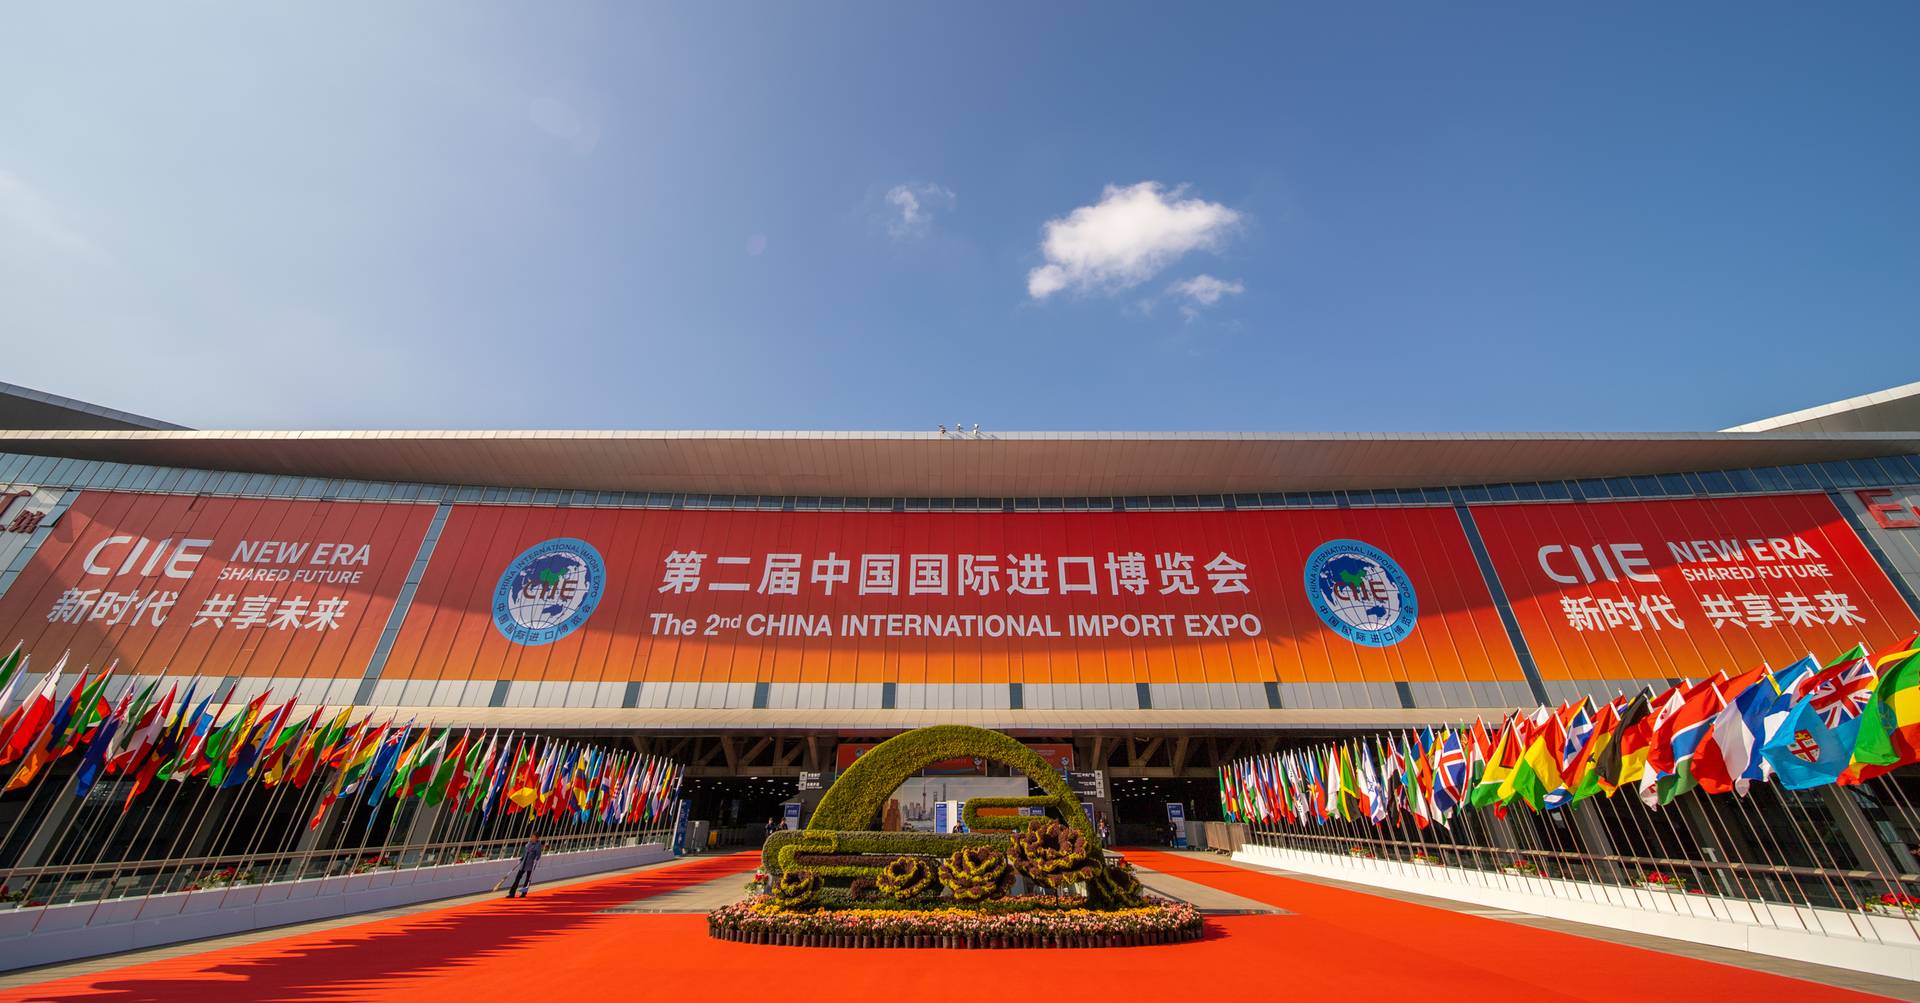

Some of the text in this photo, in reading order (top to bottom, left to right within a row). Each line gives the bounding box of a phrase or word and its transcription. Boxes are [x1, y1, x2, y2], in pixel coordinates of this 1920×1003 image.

[82, 535, 215, 580] CIIE
[230, 540, 371, 566] NEW ERA
[1537, 543, 1660, 584] CIIE
[1667, 536, 1821, 563] NEW ERA
[217, 567, 364, 584] SHARED FUTURE
[499, 543, 601, 598] CHINA INTERNATIONAL IMPORT EXPO
[657, 551, 1250, 596] 第二届中国国际进口博览会
[1309, 544, 1411, 599] CHINA INTERNATIONAL IMPORT EXPO
[1682, 563, 1833, 582] SHARED FUTURE
[47, 588, 350, 632] 新时代 共享未来
[649, 613, 1262, 637] The 2nd CHINA INTERNATIONAL IMPORT EXPO
[1560, 590, 1866, 632] 新时代 共享未来
